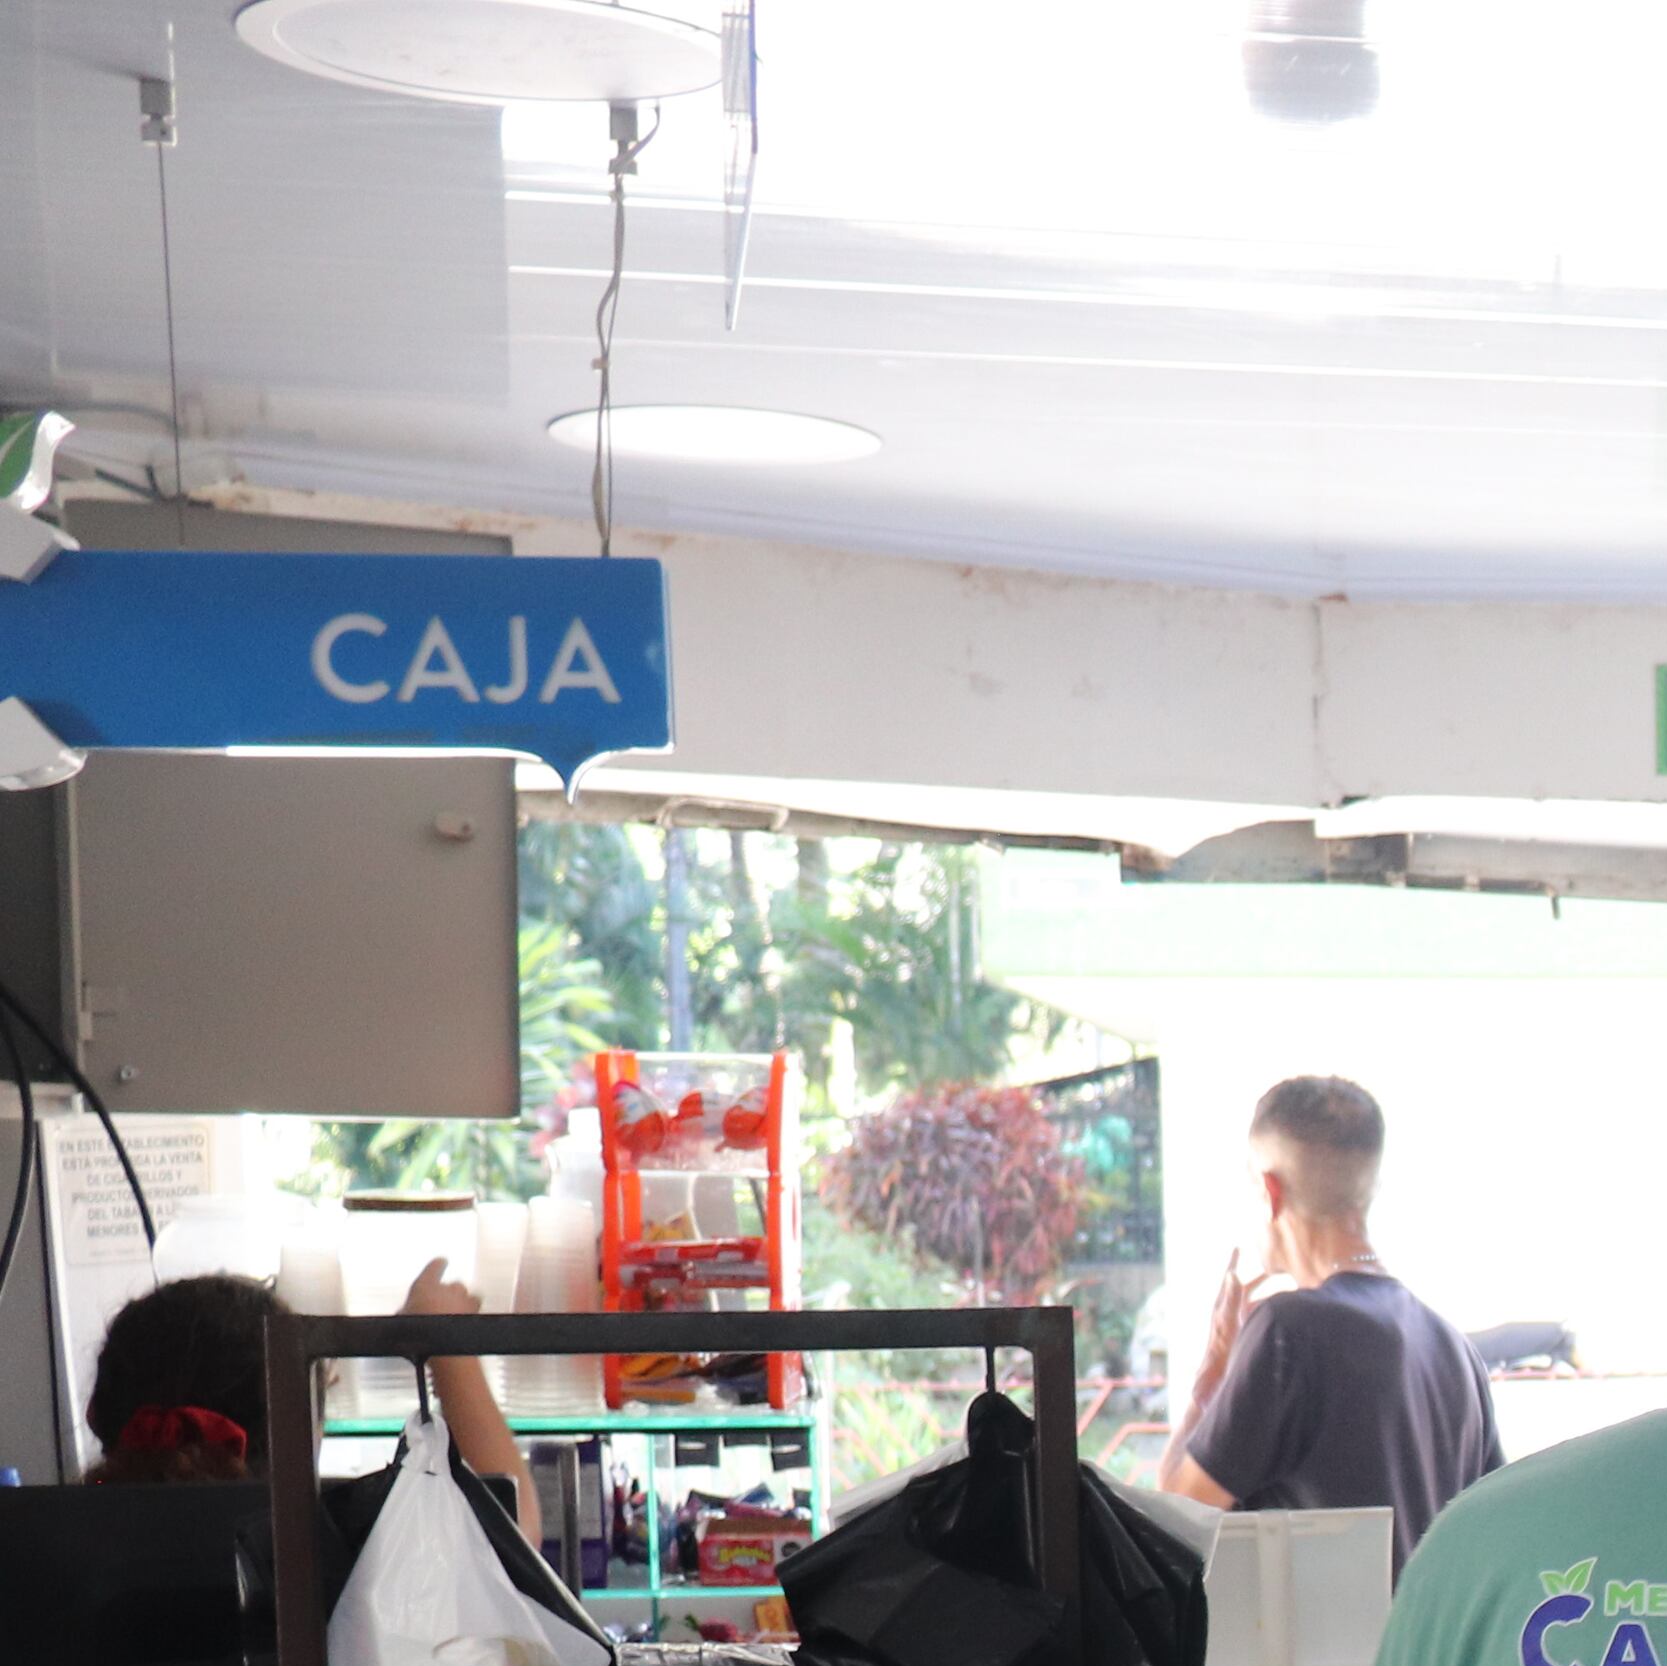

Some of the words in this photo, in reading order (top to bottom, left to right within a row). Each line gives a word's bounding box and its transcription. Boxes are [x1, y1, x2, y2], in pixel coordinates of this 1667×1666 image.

[311, 612, 622, 703] CAJA
[107, 1134, 205, 1150] ETABLECIMIENTO
[71, 1190, 134, 1204] PRODUCTO
[144, 1185, 200, 1200] ERIVADOS
